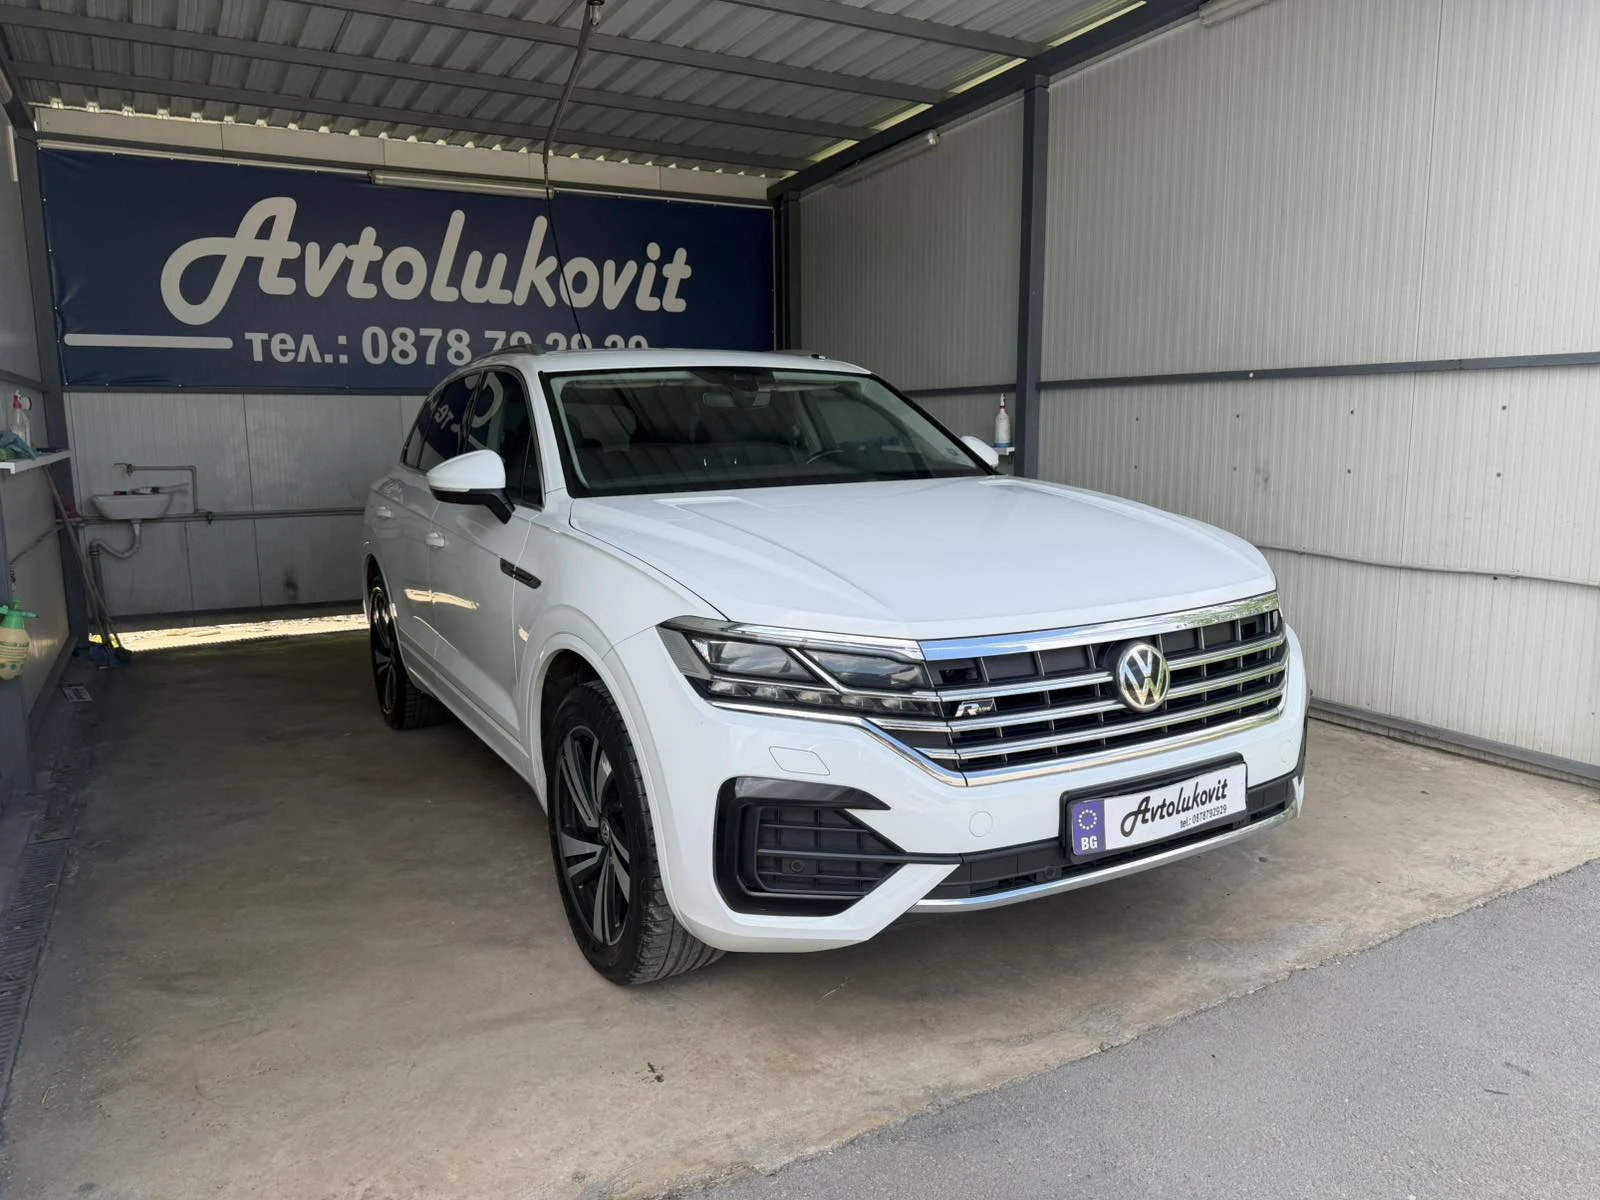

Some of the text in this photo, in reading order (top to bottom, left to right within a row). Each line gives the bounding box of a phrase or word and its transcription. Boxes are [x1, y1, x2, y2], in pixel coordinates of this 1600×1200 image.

[160, 196, 692, 327] Avtolukovit
[244, 331, 348, 364] тел.:
[361, 326, 472, 366] 0878
[1120, 778, 1228, 838] Avtolukovit
[1080, 835, 1098, 851] BG
